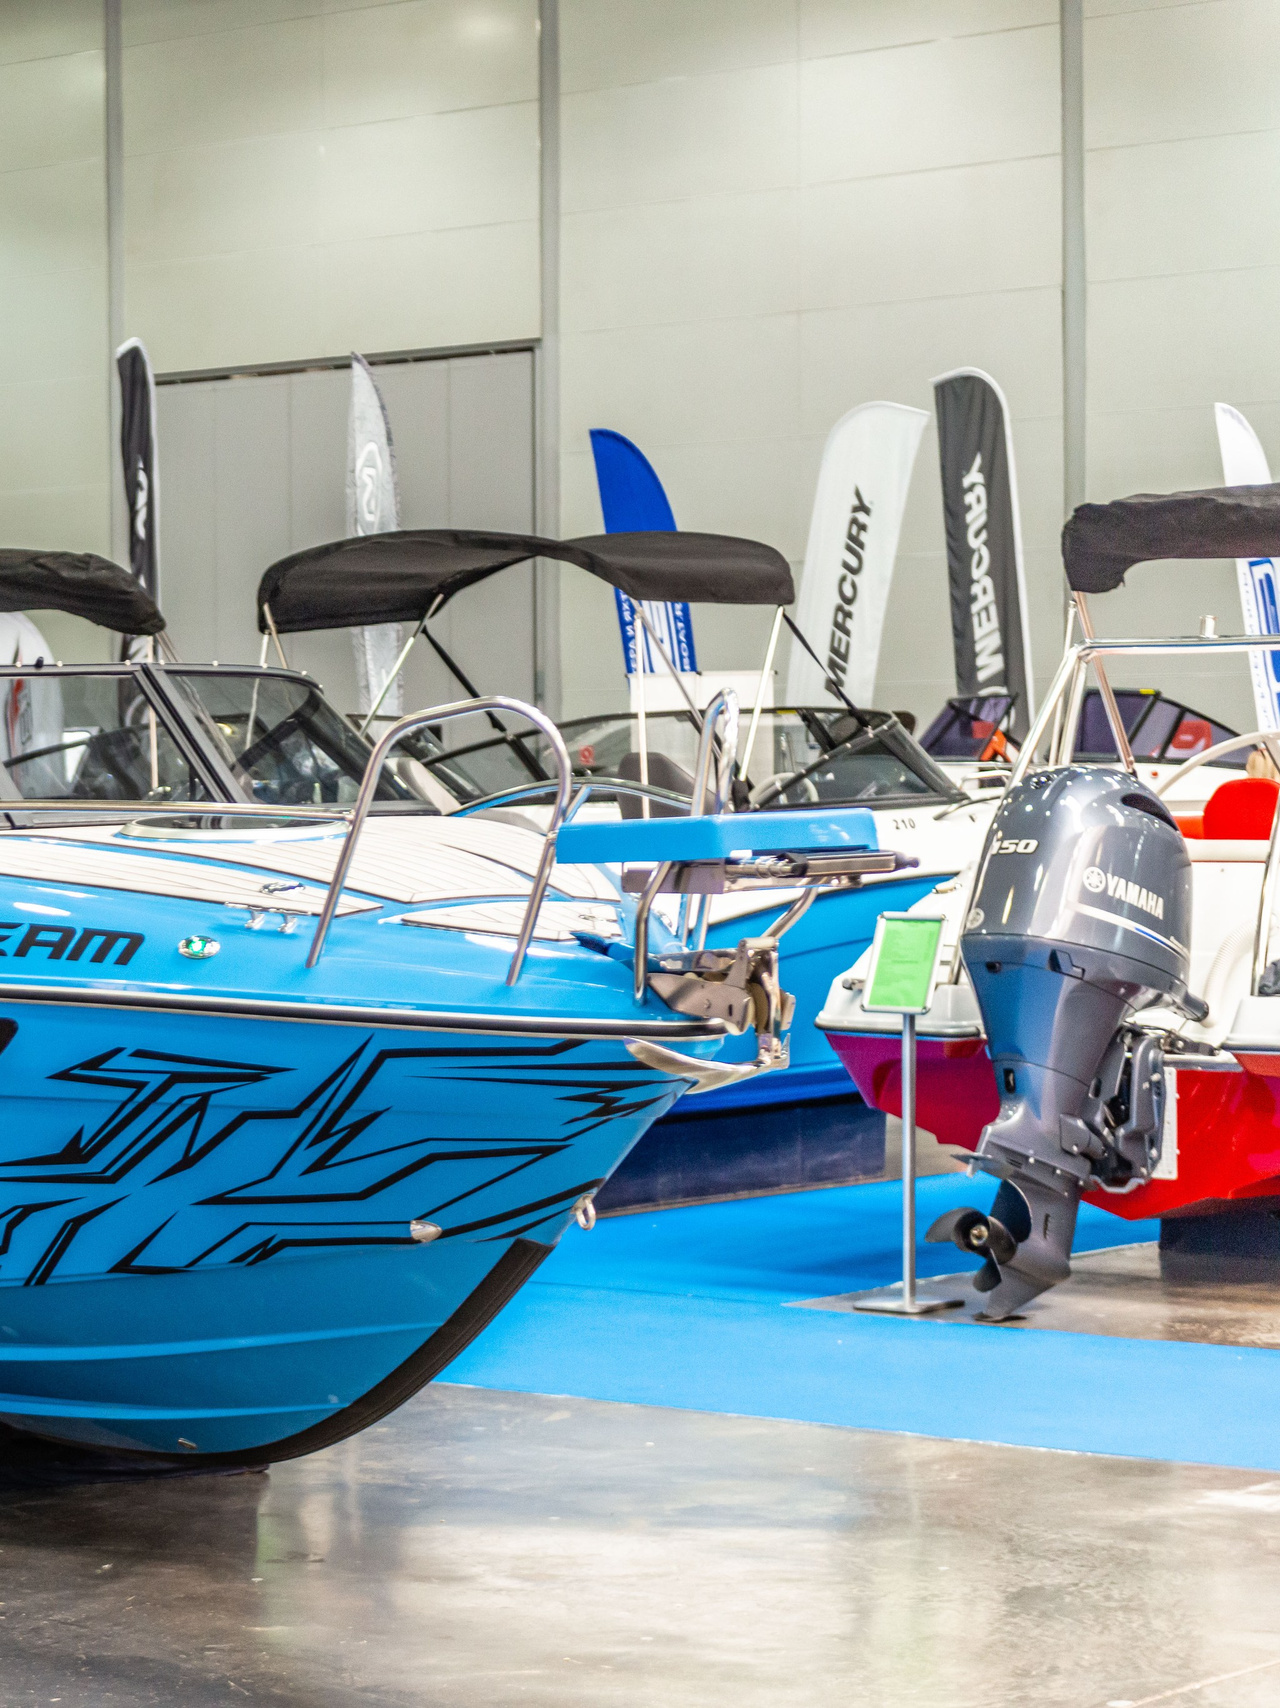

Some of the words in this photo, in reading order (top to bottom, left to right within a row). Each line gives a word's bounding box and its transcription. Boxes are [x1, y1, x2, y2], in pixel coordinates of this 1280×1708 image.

[825, 484, 871, 701] MERCURY
[893, 818, 916, 830] 210
[1106, 873, 1164, 920] YAMAHA
